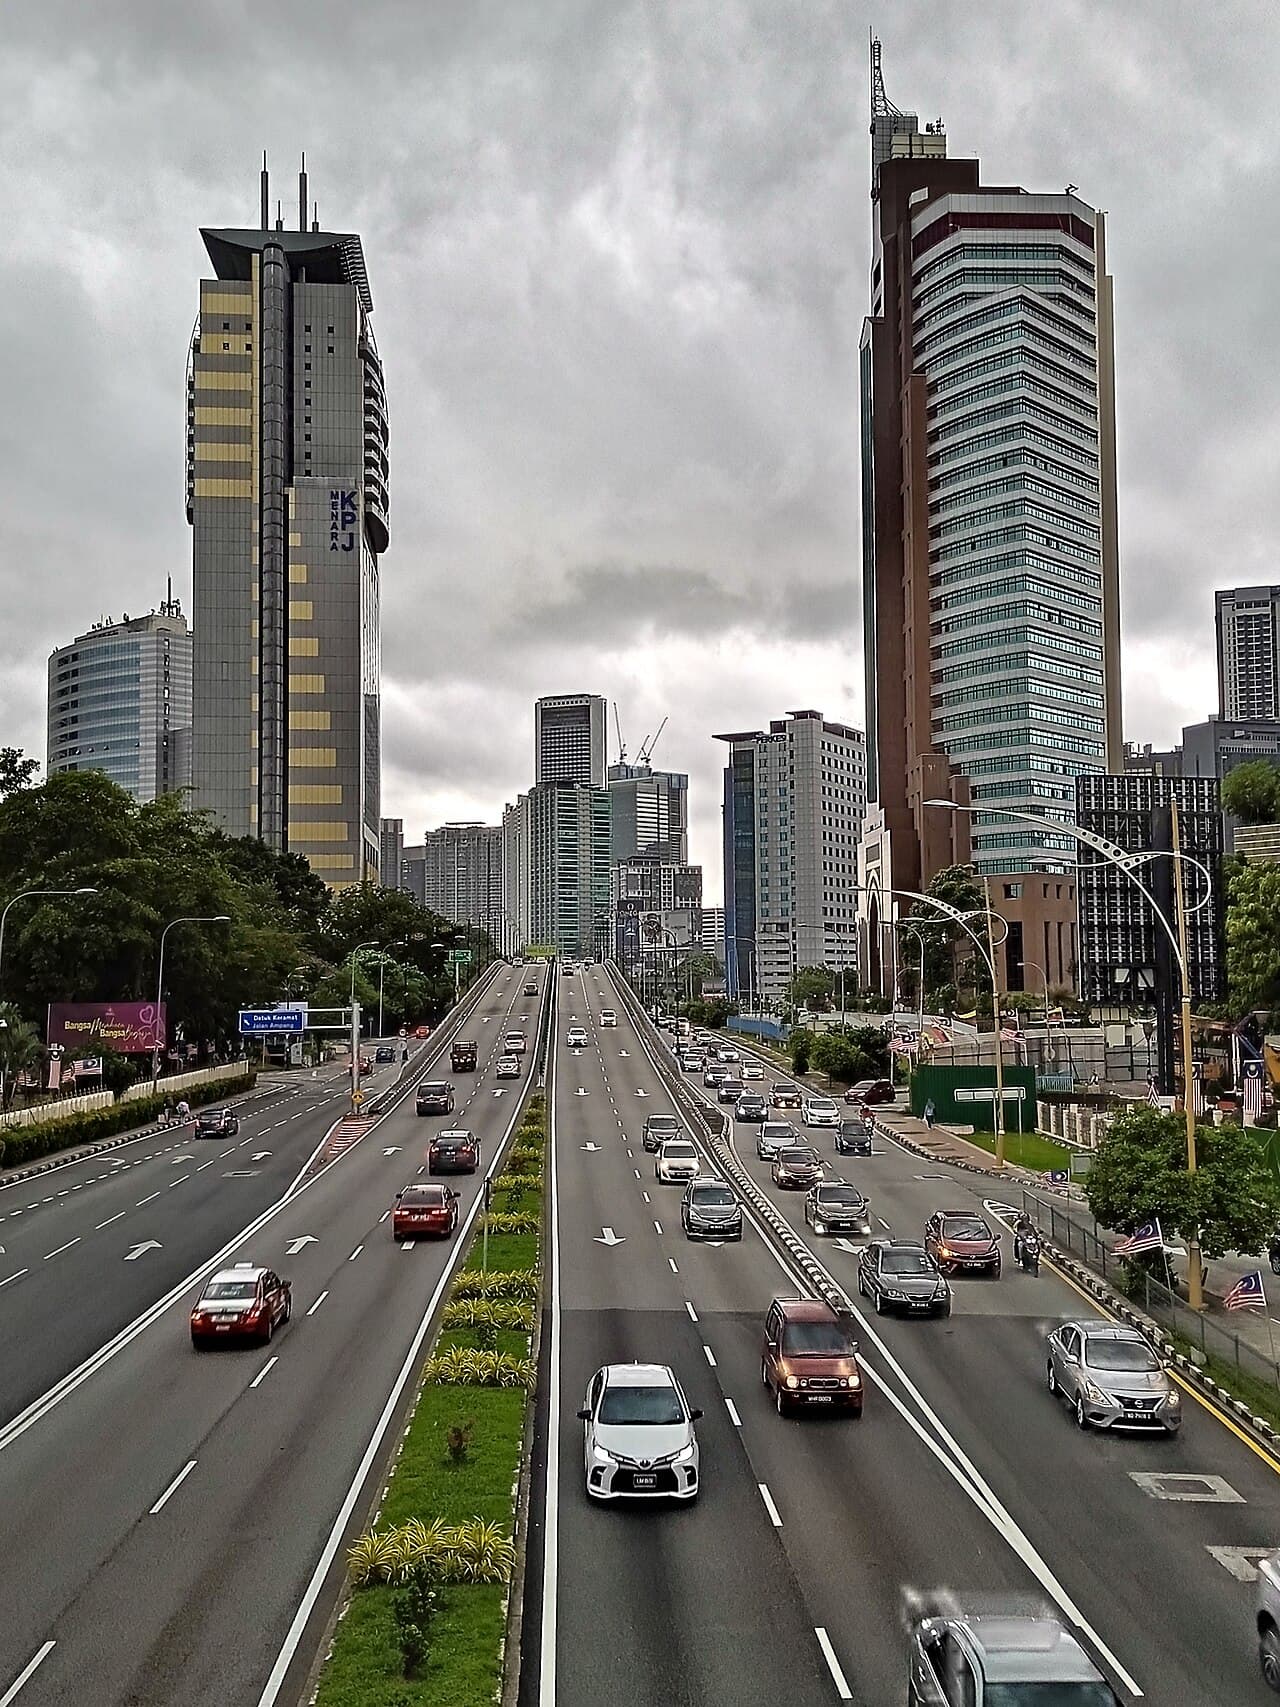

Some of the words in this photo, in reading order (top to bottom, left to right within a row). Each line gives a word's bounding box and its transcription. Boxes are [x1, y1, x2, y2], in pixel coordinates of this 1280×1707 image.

[330, 490, 340, 551] MENARA
[340, 490, 357, 552] KPJ
[64, 1020, 92, 1032] Bangsa
[99, 1028, 125, 1039] Bangsa
